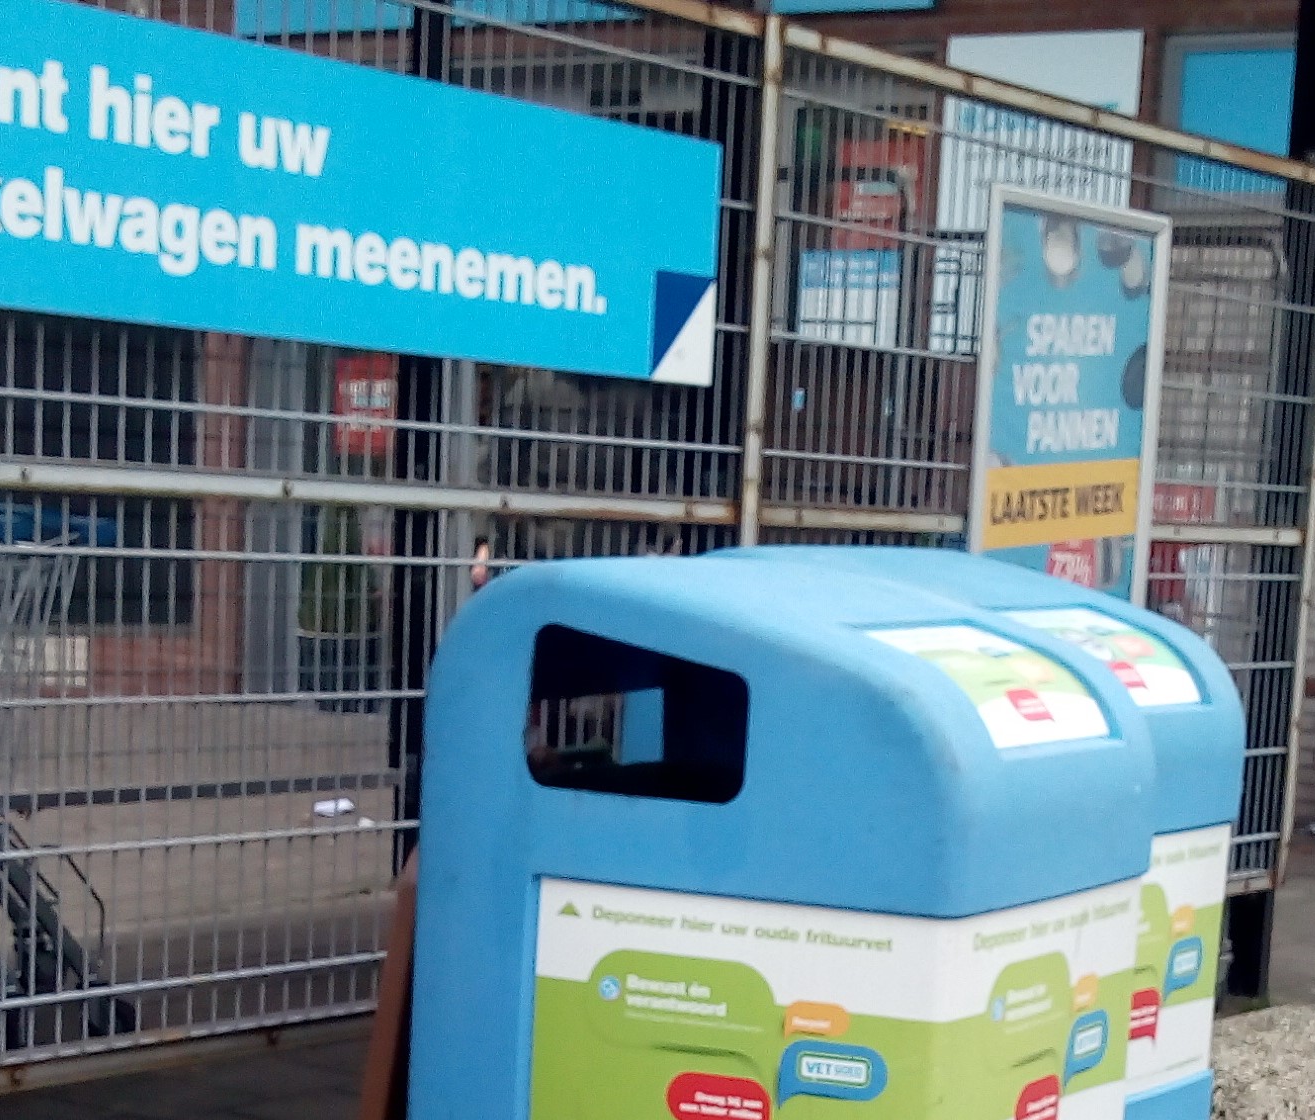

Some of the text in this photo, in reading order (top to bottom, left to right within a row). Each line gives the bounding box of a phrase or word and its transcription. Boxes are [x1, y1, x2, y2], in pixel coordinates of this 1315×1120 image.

[89, 64, 221, 158] hier
[238, 110, 332, 178] uw
[295, 222, 609, 316] meenemen.
[1026, 314, 1117, 357] SPAREN
[1012, 362, 1080, 406] VOOR
[1026, 408, 1120, 454] PANNEN
[990, 487, 1071, 526] LAATSTE
[1074, 482, 1126, 516] WEEK
[592, 904, 675, 927] Deponeer
[679, 914, 715, 932] hier
[721, 923, 749, 935] uw
[754, 926, 800, 942] oude
